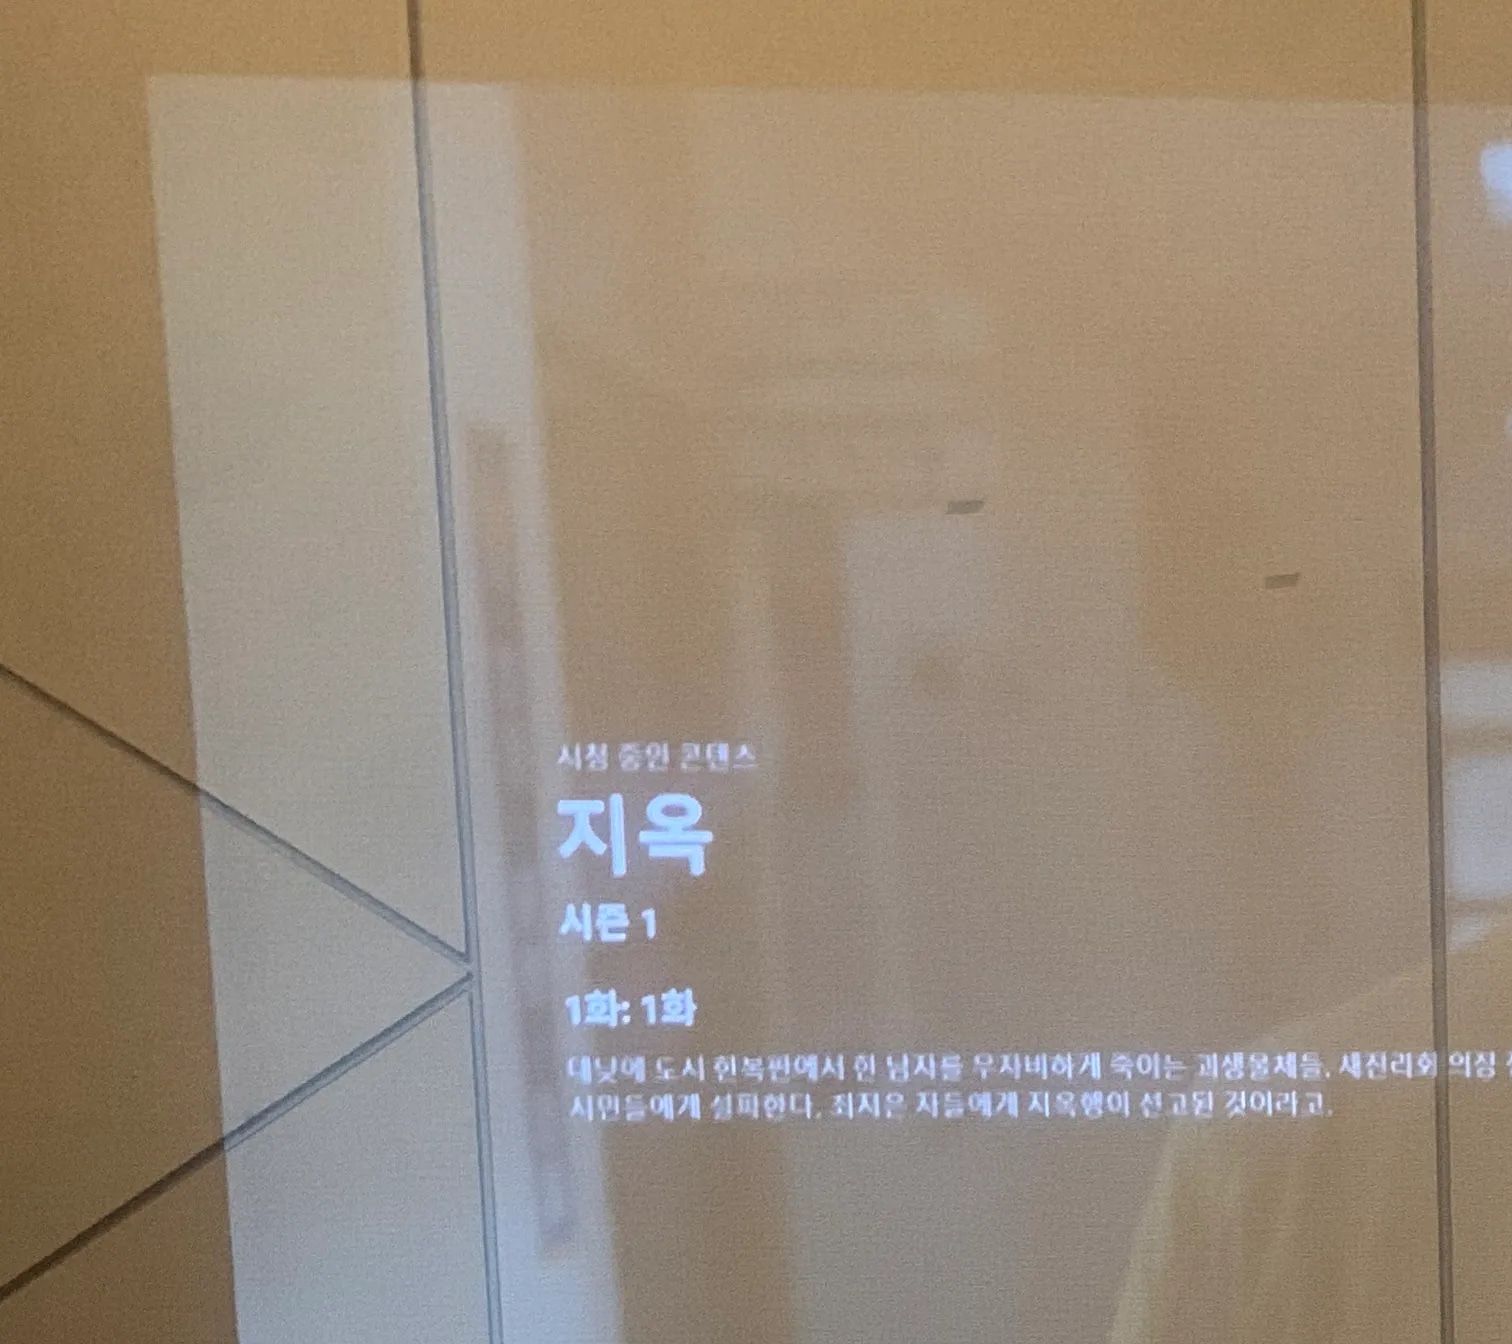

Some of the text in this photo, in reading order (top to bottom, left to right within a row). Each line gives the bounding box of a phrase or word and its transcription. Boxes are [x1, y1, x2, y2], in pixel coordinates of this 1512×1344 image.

[556, 793, 713, 877] 지옥
[558, 902, 657, 942] 시즌 1
[565, 989, 696, 1027] 1화: 1화
[886, 1052, 963, 1082] 남자를
[971, 1052, 1102, 1081] 무자비하게
[1110, 1051, 1187, 1080] 죽이는
[569, 1092, 701, 1121] 시민들에게
[916, 1090, 1018, 1119] 자들에게
[1028, 1090, 1130, 1118] 지옥행이
